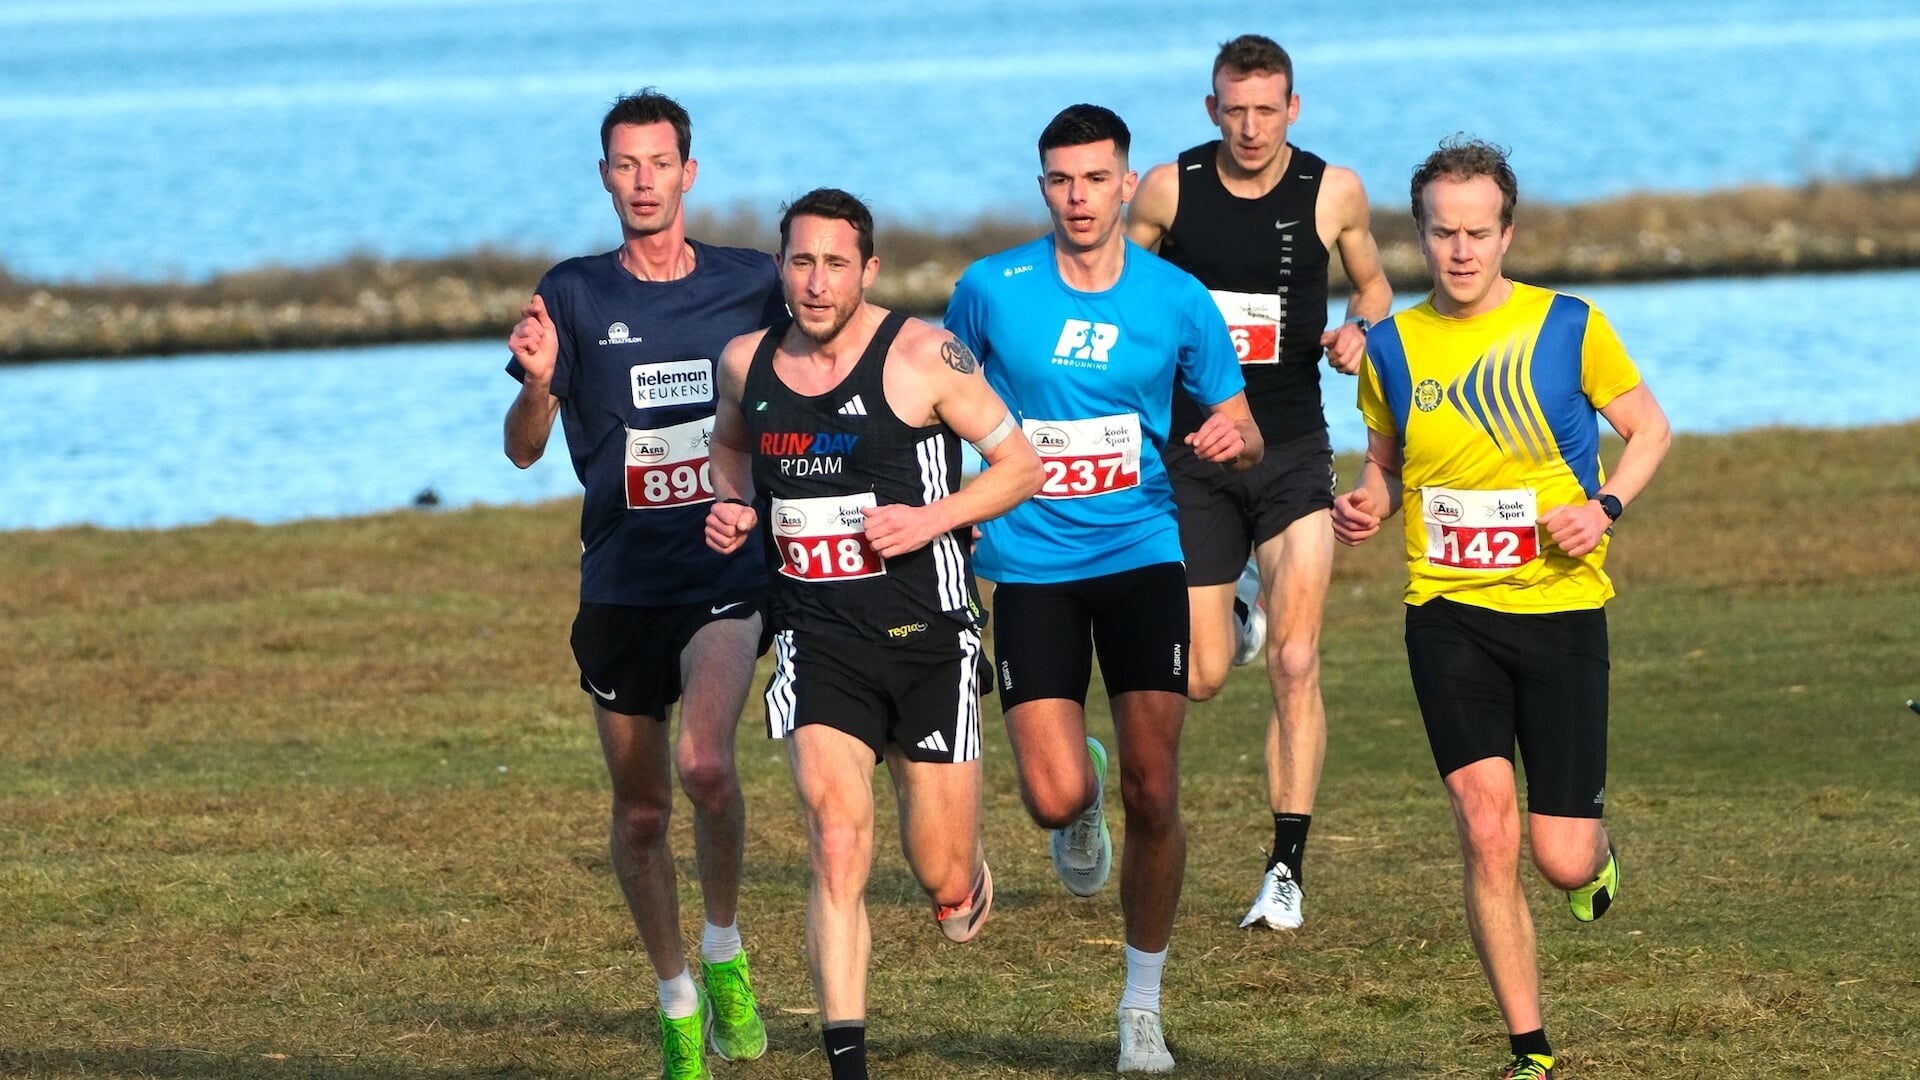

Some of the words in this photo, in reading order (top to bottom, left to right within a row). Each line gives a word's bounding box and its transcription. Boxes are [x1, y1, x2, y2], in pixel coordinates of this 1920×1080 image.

[1279, 233, 1293, 276] NIKE
[1014, 264, 1033, 275] JAKO
[636, 369, 708, 387] tieleman
[638, 383, 709, 401] KEUKENS
[780, 456, 842, 477] R'DAM
[1041, 456, 1123, 493] 237
[839, 506, 862, 517] kool
[787, 538, 865, 575] 918
[1443, 530, 1522, 565] 142
[887, 624, 918, 638] regio
[1173, 643, 1182, 676] FUSION
[1001, 660, 1013, 691] FUSION
